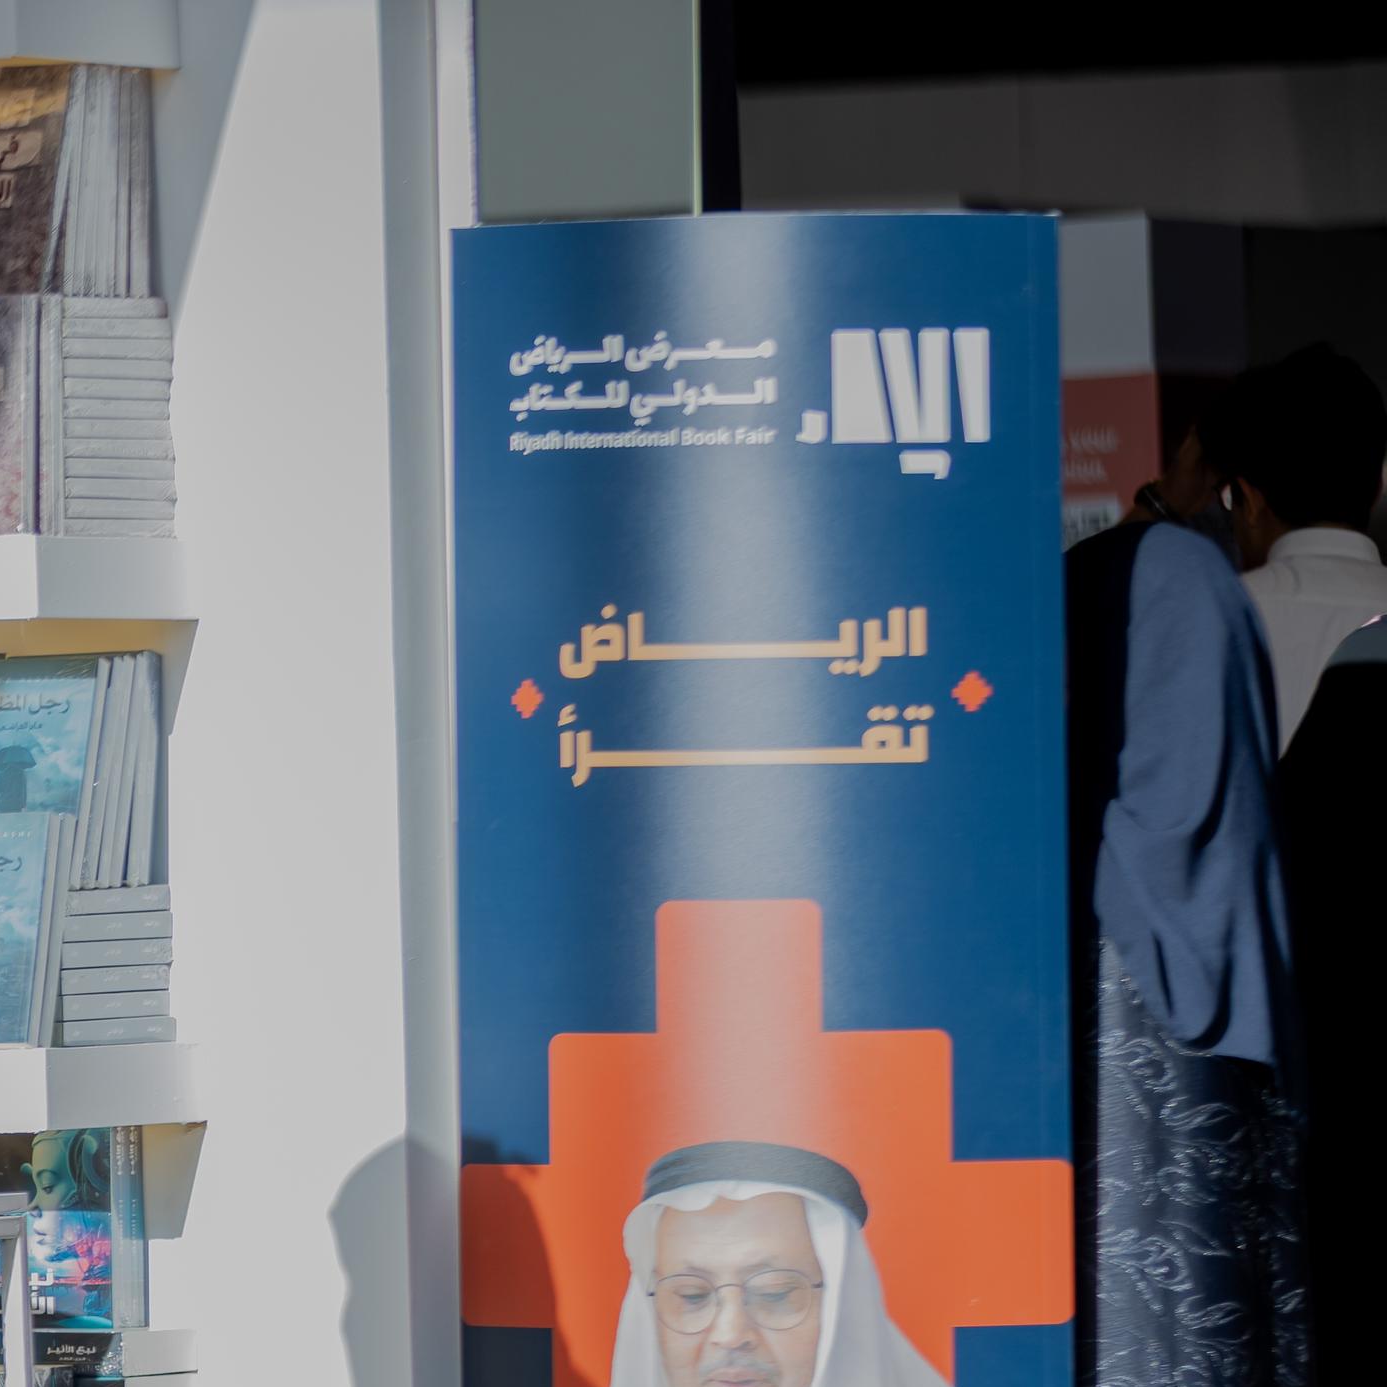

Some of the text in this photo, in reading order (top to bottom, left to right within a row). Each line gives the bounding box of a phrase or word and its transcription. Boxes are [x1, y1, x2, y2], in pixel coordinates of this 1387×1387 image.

[510, 331, 776, 375] معرض الرياض
[509, 377, 778, 426] الدولي للكتاب
[509, 426, 776, 455] Riyadh International Book Fair
[559, 603, 928, 680] الرياض
[29, 694, 70, 715] رجل
[557, 703, 935, 788] تقرأ
[76, 1345, 96, 1355] نبع
